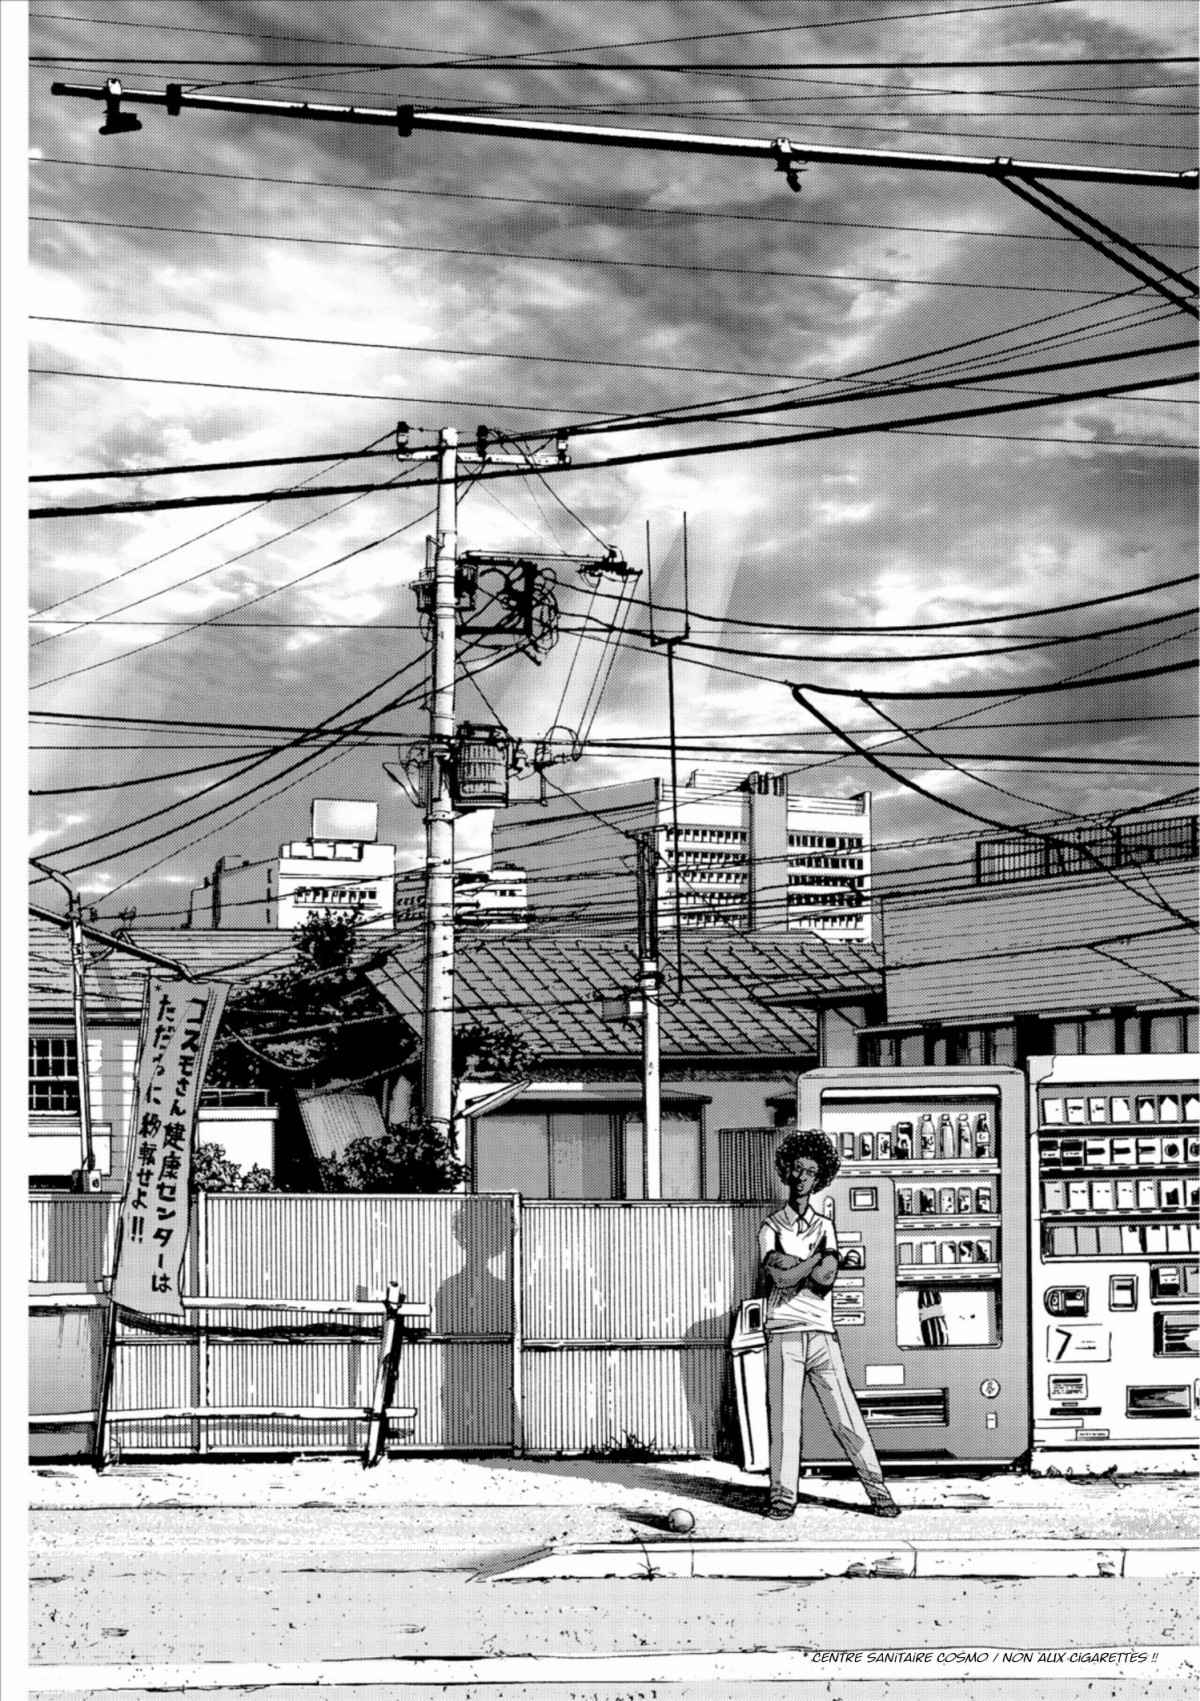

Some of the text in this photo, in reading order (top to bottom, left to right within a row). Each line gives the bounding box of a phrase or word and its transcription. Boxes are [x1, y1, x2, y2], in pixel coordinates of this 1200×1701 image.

[151, 998, 209, 1293] コスモさん健康センターは
